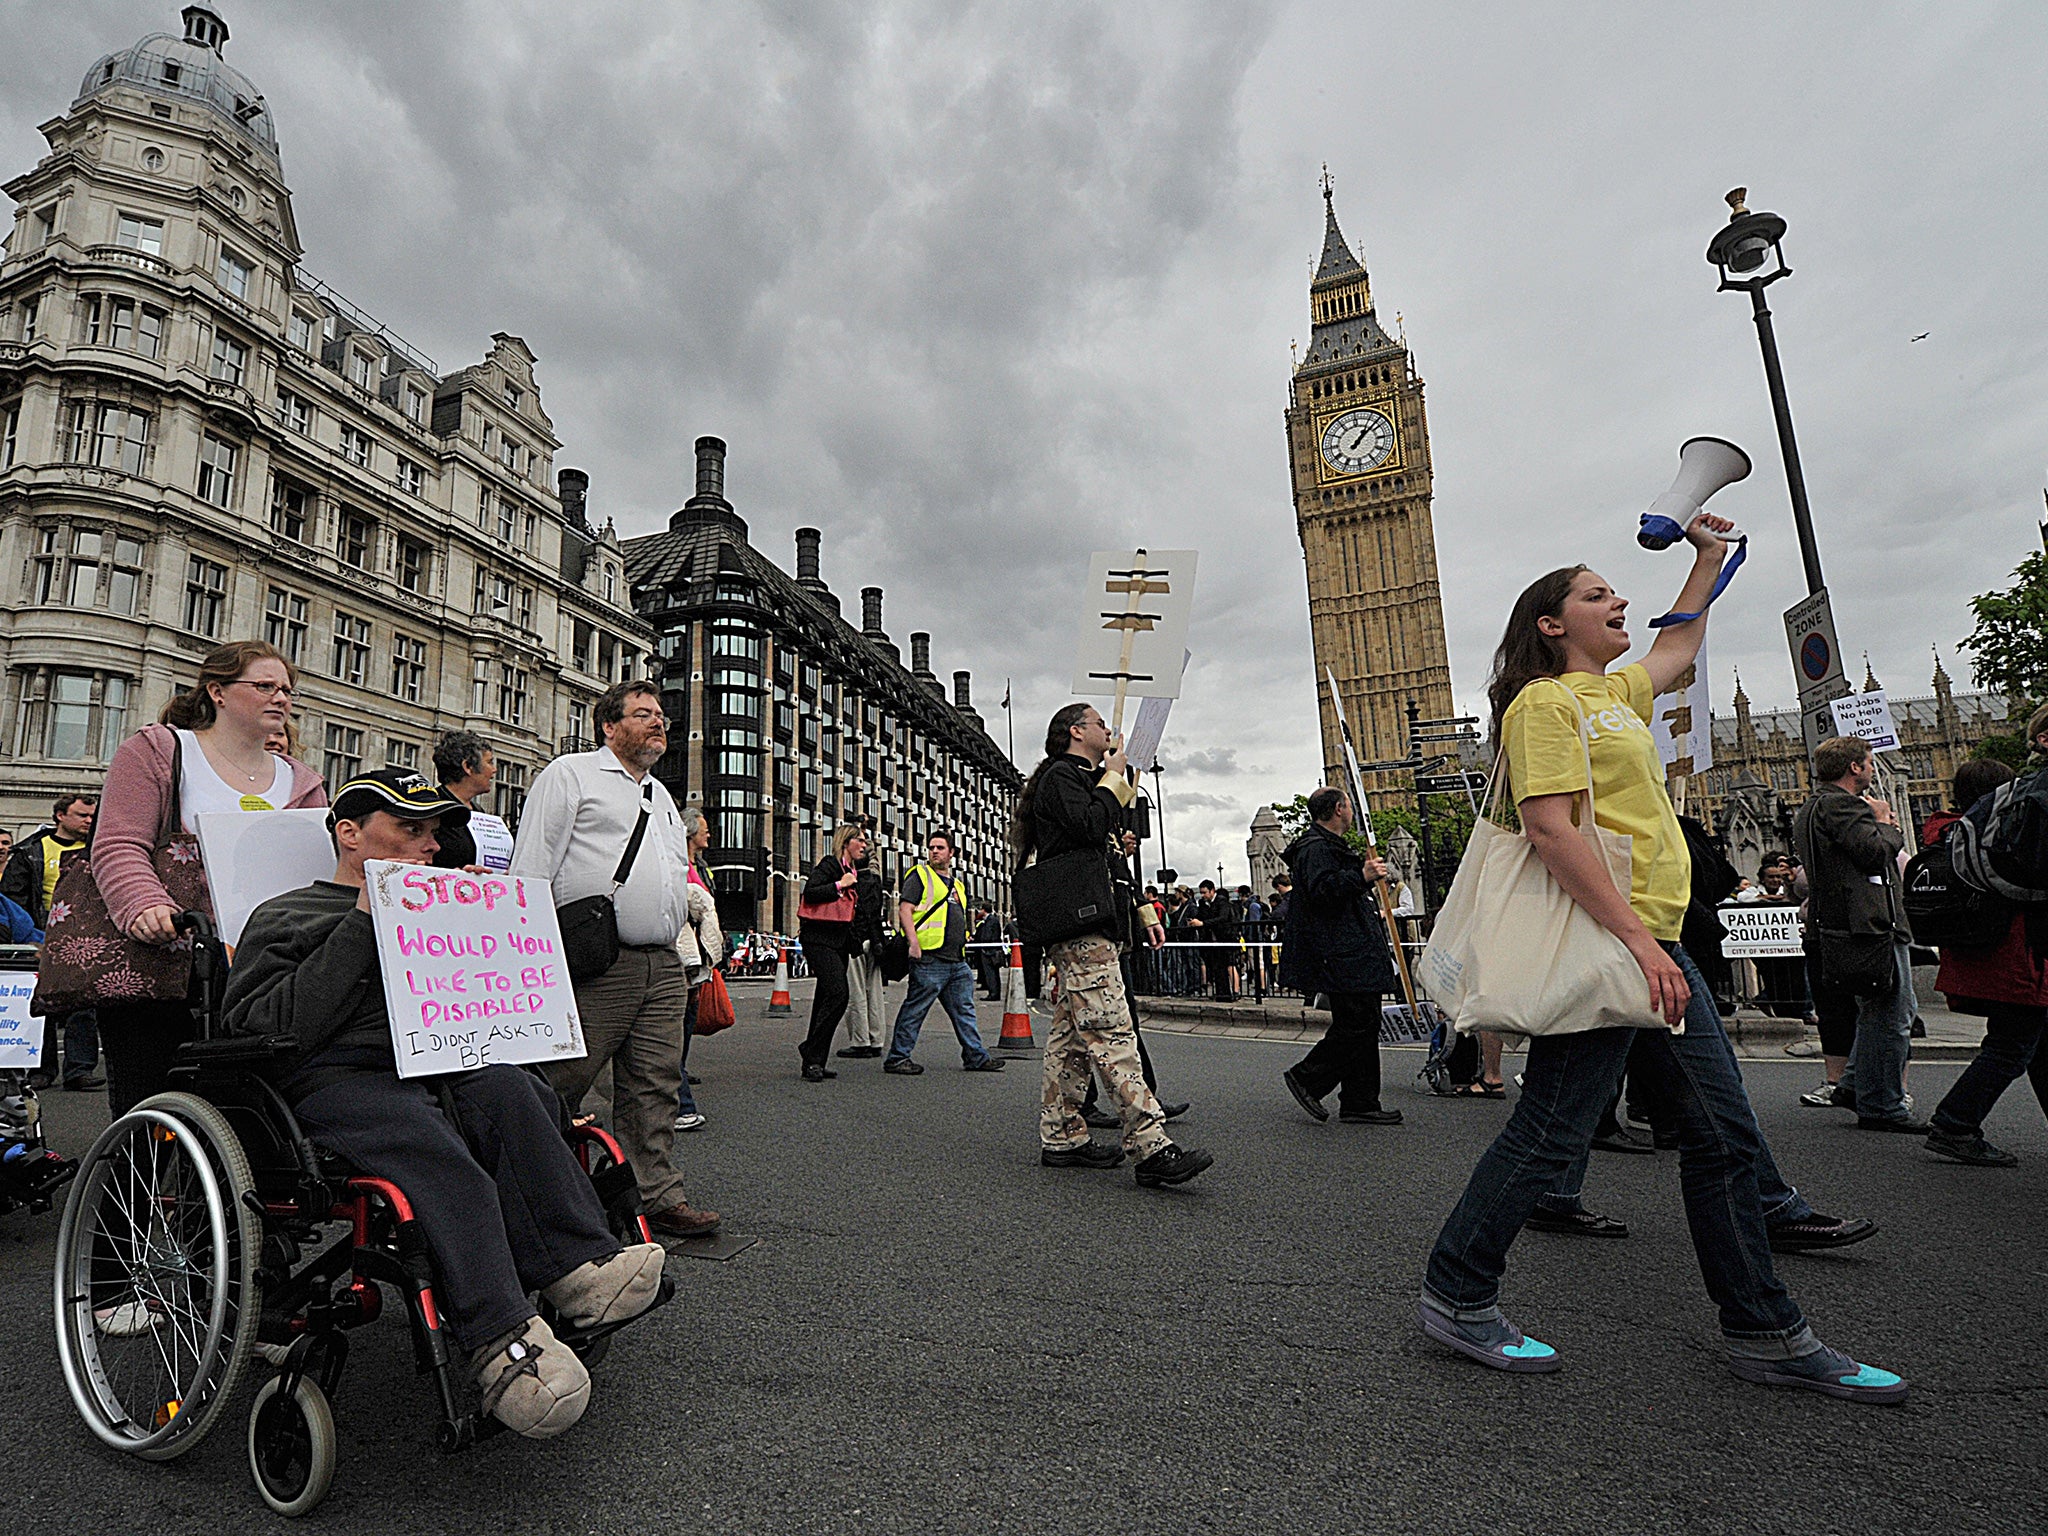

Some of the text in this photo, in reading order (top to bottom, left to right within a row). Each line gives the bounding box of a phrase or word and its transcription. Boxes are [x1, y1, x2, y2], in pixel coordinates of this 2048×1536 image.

[1787, 594, 1826, 624] Controlled
[1795, 611, 1823, 637] ZONE
[1837, 698, 1881, 711] No Jobs
[1840, 707, 1883, 720] No Help
[1849, 726, 1884, 738] HOPE!
[1856, 718, 1872, 727] NO
[401, 870, 527, 925] STOP!
[396, 924, 554, 959] WOULD YOU
[1729, 927, 1790, 942] SQUARE
[11, 984, 33, 1000] Away
[406, 964, 557, 996] LIKE TO BE
[421, 993, 544, 1028] DISABLED
[1392, 1014, 1410, 1036] STOP
[406, 1031, 424, 1056] I
[488, 1025, 529, 1041] ASK
[529, 1023, 554, 1038] TO
